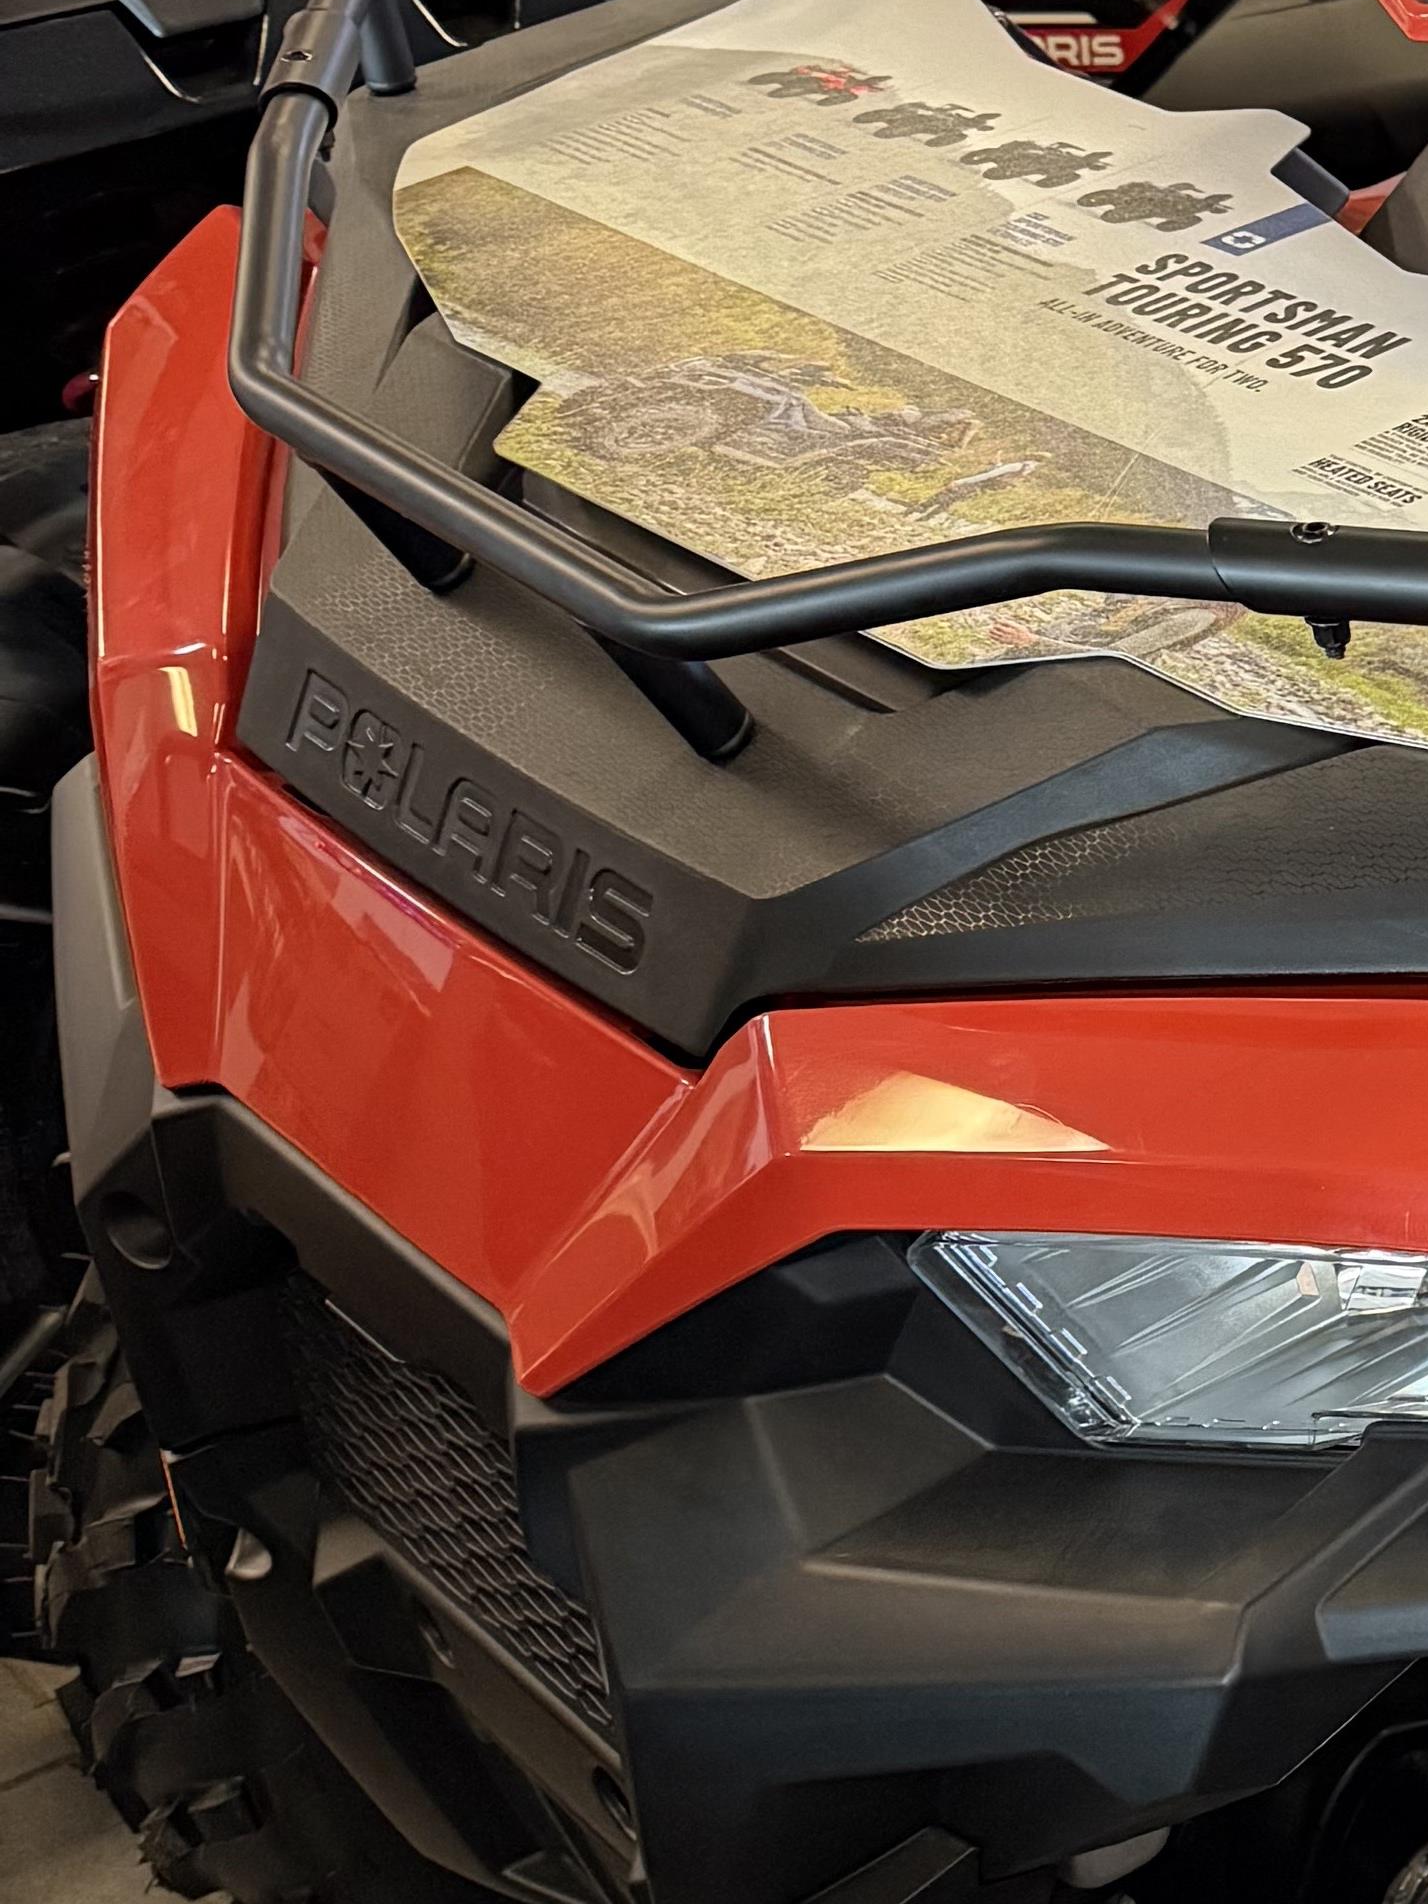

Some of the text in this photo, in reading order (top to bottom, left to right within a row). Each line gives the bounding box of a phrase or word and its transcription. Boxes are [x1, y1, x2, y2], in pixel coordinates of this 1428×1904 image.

[1039, 298, 1272, 393] ALL-IN ADVENTURE FOR TWO.
[1081, 273, 1373, 390] TOURING 570
[1135, 253, 1412, 359] SPORTSMAN
[1308, 457, 1424, 505] HEATED SEATS
[284, 668, 654, 976] POLARIS
